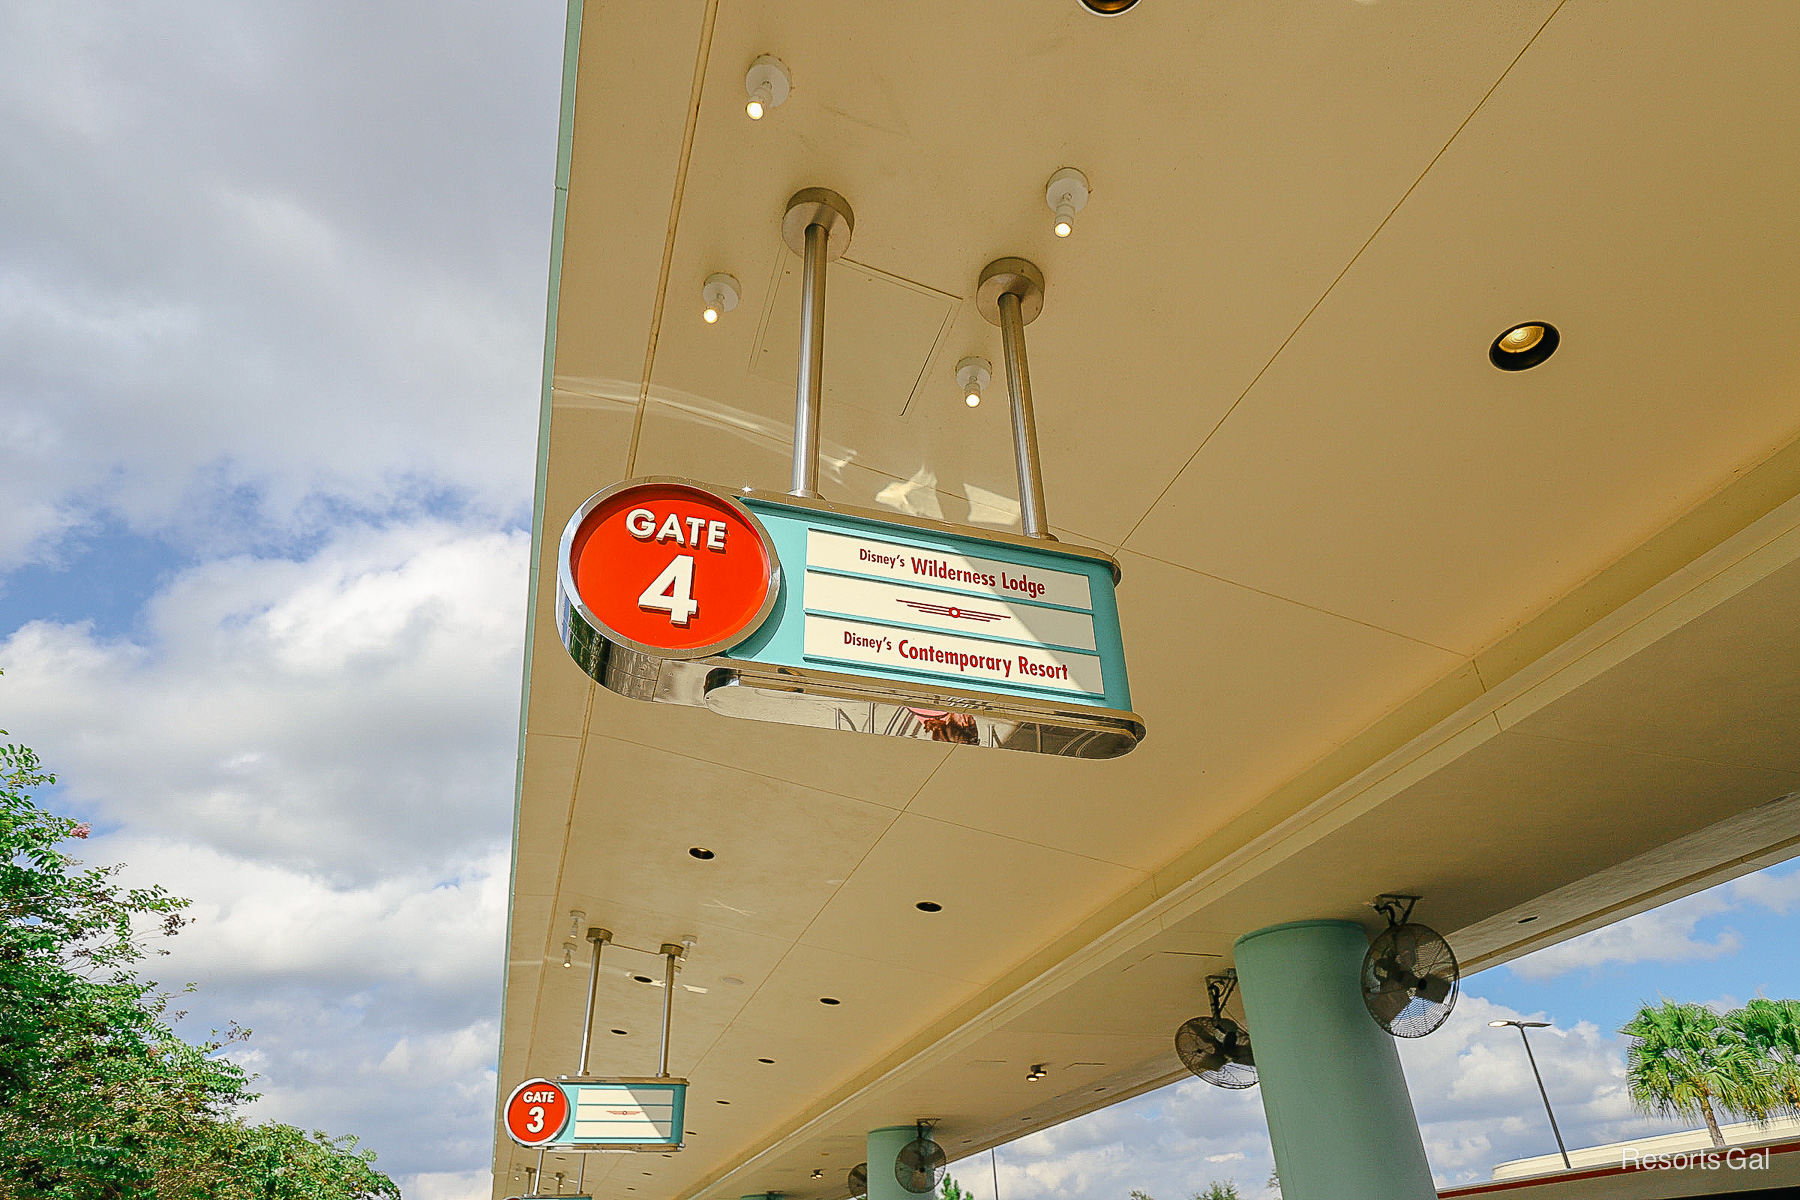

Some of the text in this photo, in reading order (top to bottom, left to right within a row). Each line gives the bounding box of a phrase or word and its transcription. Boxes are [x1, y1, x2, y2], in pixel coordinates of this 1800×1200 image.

[625, 508, 727, 550] GATE
[638, 554, 698, 625] 4
[859, 548, 1046, 599] Disney's Wilderness Lodge
[843, 631, 1068, 681] Disney's Contemporary Resort
[523, 1091, 555, 1104] GATE
[526, 1106, 545, 1133] 3
